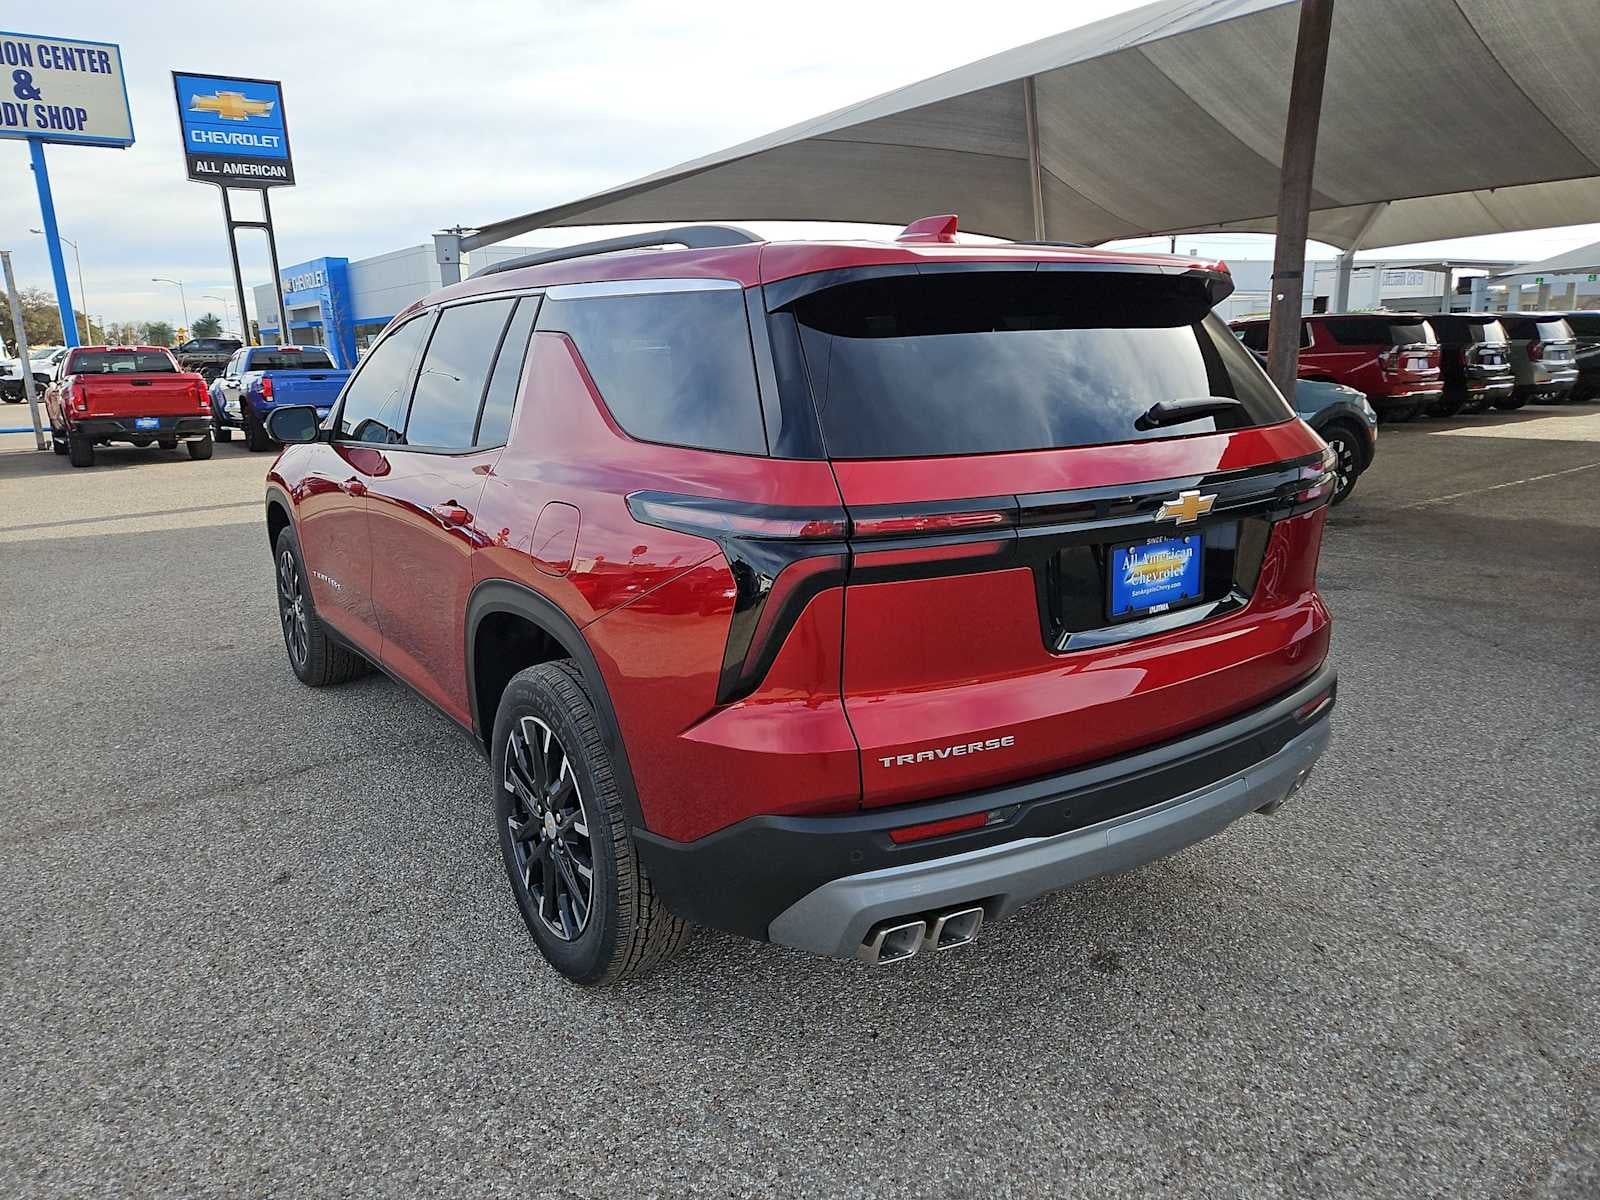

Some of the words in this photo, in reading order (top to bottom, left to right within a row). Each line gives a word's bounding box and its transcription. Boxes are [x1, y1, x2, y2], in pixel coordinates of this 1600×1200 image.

[37, 44, 112, 74] CENTER
[12, 69, 42, 101] &
[0, 102, 28, 127] DY
[34, 104, 88, 131] SHOP
[191, 130, 280, 148] CHEVROLET
[196, 161, 220, 173] ALL
[223, 162, 287, 177] AMERICAN
[1146, 536, 1163, 545] SINCE
[1122, 553, 1139, 571] All
[1141, 547, 1193, 565] American
[1131, 565, 1185, 586] Chevrolet
[879, 735, 1015, 768] TRAVERSE
